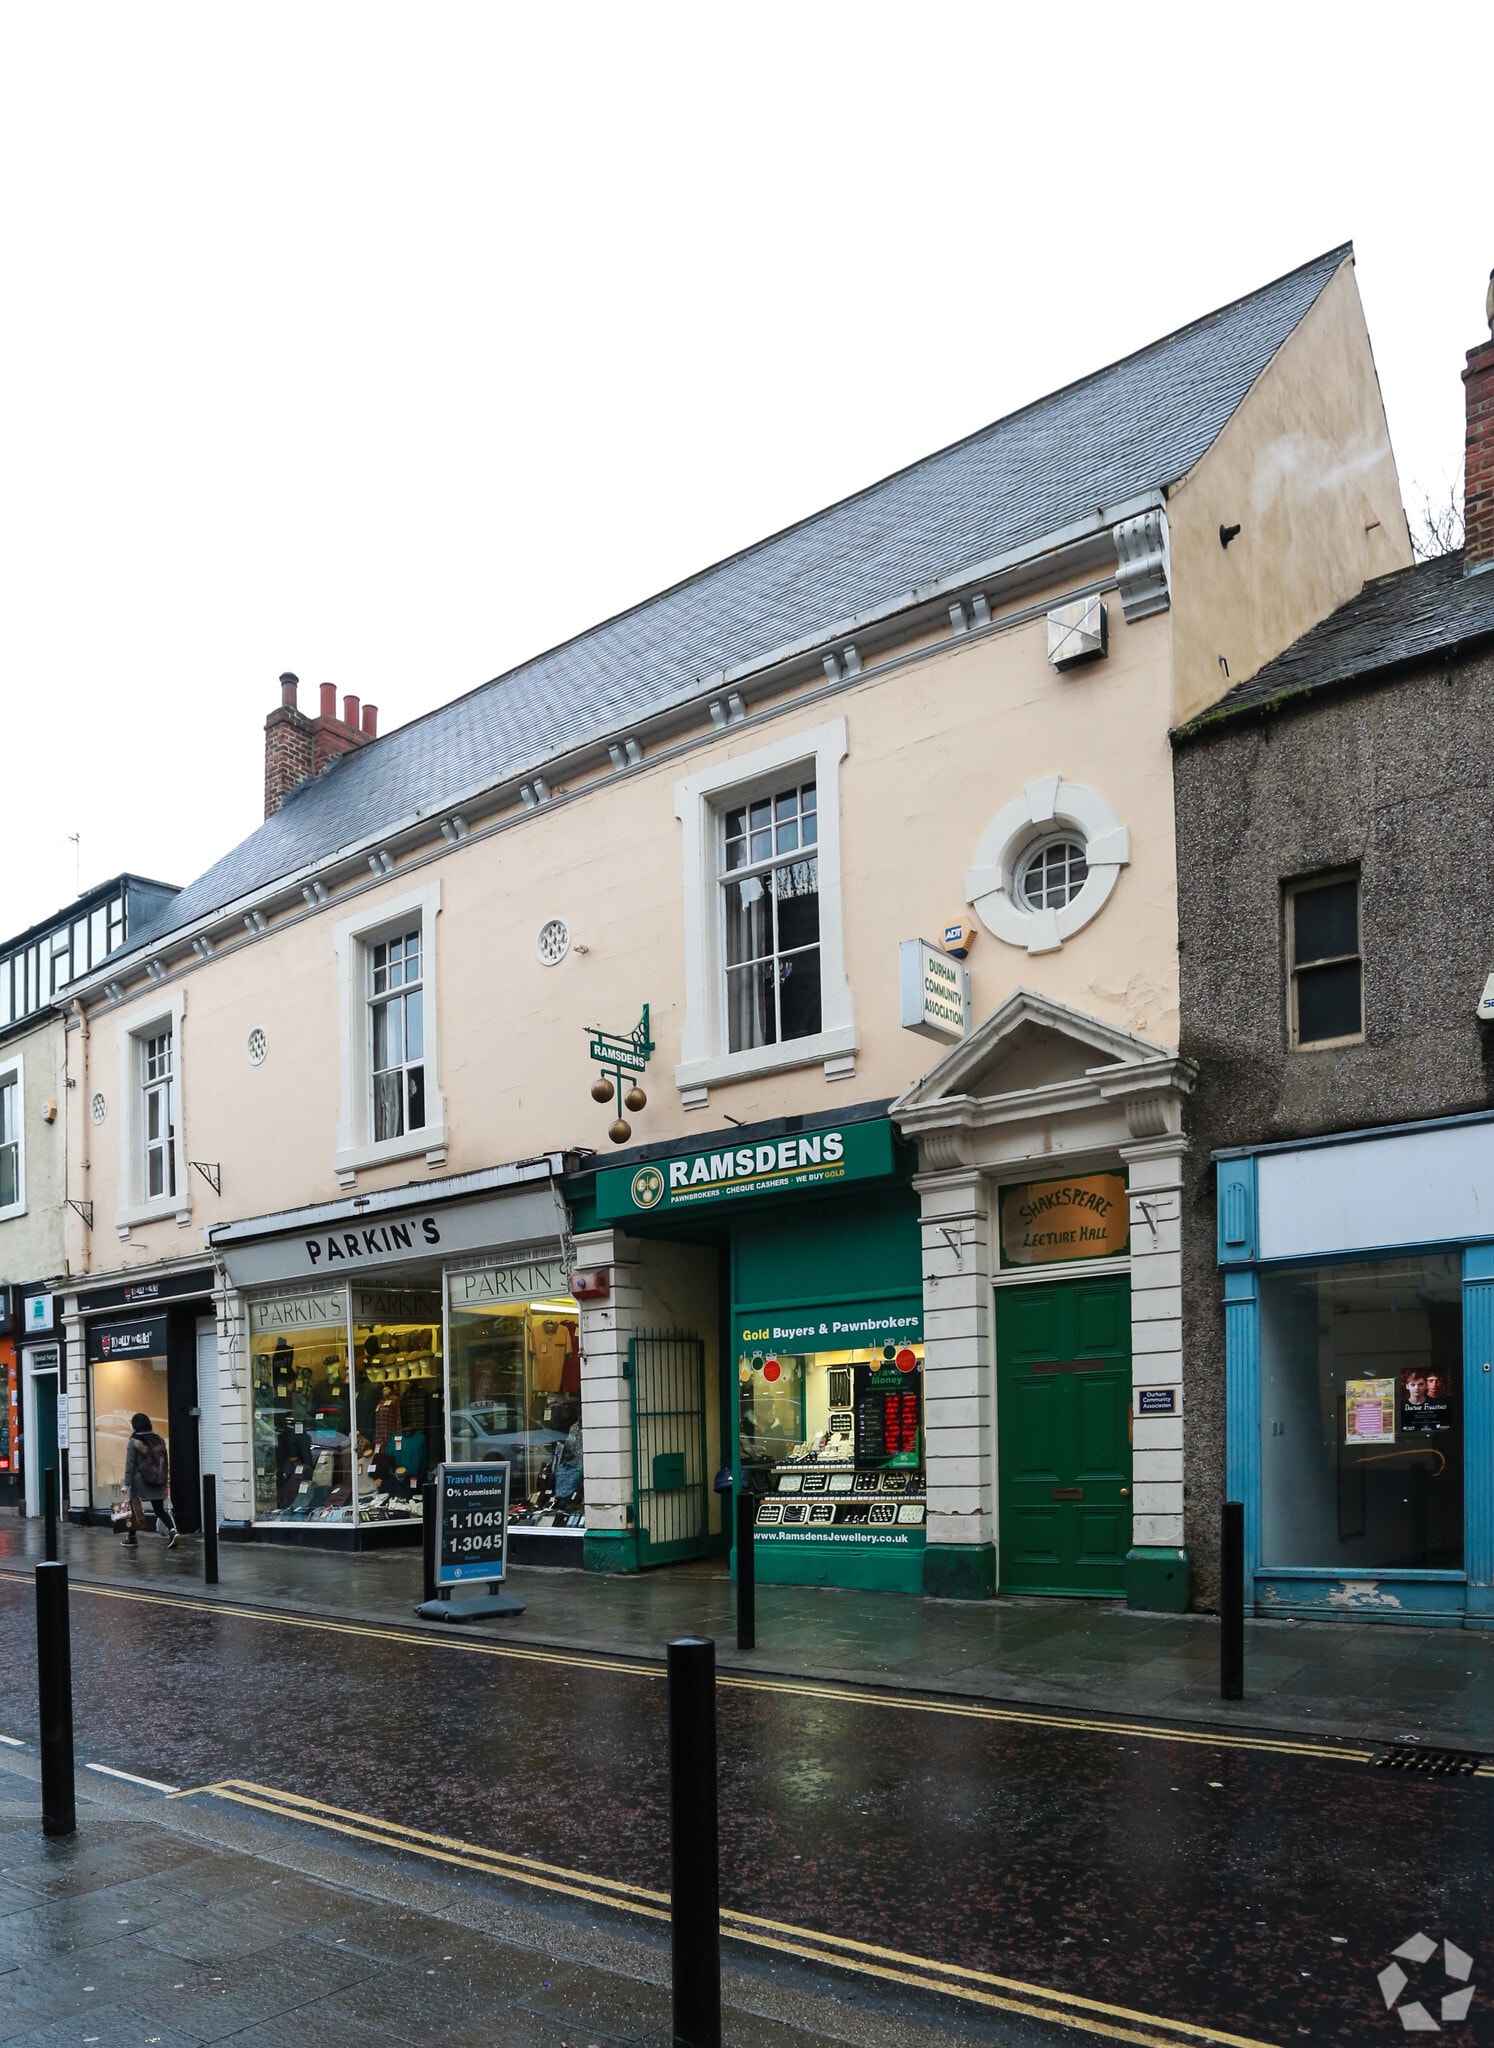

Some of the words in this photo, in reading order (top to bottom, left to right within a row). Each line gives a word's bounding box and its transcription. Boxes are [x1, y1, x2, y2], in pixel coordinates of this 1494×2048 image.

[946, 927, 962, 939] ADT
[929, 958, 957, 984] DURHAM
[925, 977, 962, 1006] COMMUNITY
[925, 998, 964, 1026] ASSOCIATION
[594, 1044, 645, 1068] RAMSDENS
[669, 1132, 844, 1188] RAMSDENS
[671, 1189, 720, 1203] PAWNBROKERS
[726, 1184, 755, 1195] CHEQUE
[756, 1178, 789, 1190] CASHERS
[796, 1175, 808, 1183] WE
[809, 1172, 824, 1181] BUY
[824, 1169, 845, 1179] GOLD
[1019, 1187, 1113, 1225] SHAKESPEARE
[306, 1217, 441, 1265] PARKIN'S
[1023, 1230, 1077, 1248] LECTURE
[1079, 1226, 1108, 1241] HALL
[743, 1329, 770, 1341] Gold
[773, 1326, 815, 1339] Buyers
[819, 1323, 828, 1335] &
[832, 1316, 919, 1333] Pawnbrokers
[872, 1376, 902, 1385] Money
[446, 1475, 473, 1484] Travel
[475, 1474, 503, 1484] Money
[446, 1488, 461, 1498] 0%
[463, 1488, 502, 1497] Commission
[450, 1511, 502, 1529] 1.1043
[450, 1534, 502, 1553] 1.3045
[753, 1531, 908, 1544] www.RamsdensJewellery.co.uk
